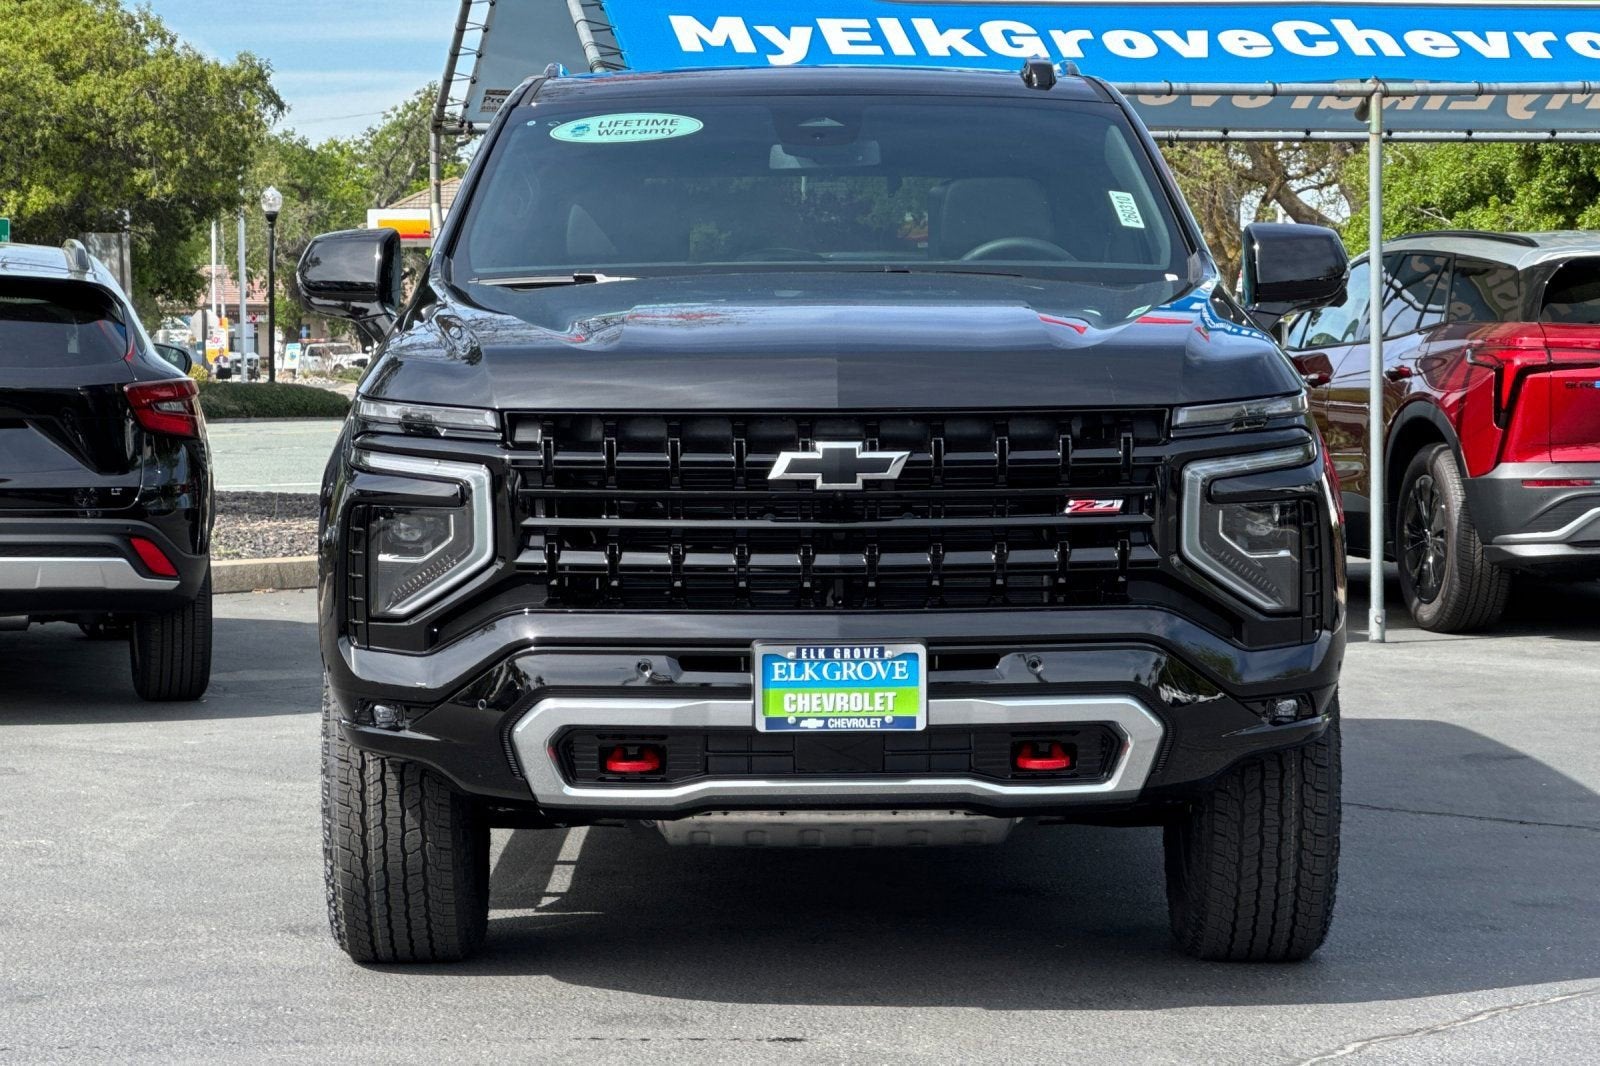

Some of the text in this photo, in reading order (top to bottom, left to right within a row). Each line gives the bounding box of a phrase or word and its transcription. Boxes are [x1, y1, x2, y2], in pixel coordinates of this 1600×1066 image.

[598, 118, 680, 129] LIFETIME
[597, 127, 678, 136] Warranty
[1115, 196, 1141, 224] 260310
[801, 648, 879, 659] ELK GROVE
[771, 660, 909, 682] ELK GROVE
[783, 692, 897, 713] CHEVROLET
[828, 718, 882, 729] CHEVROLET
